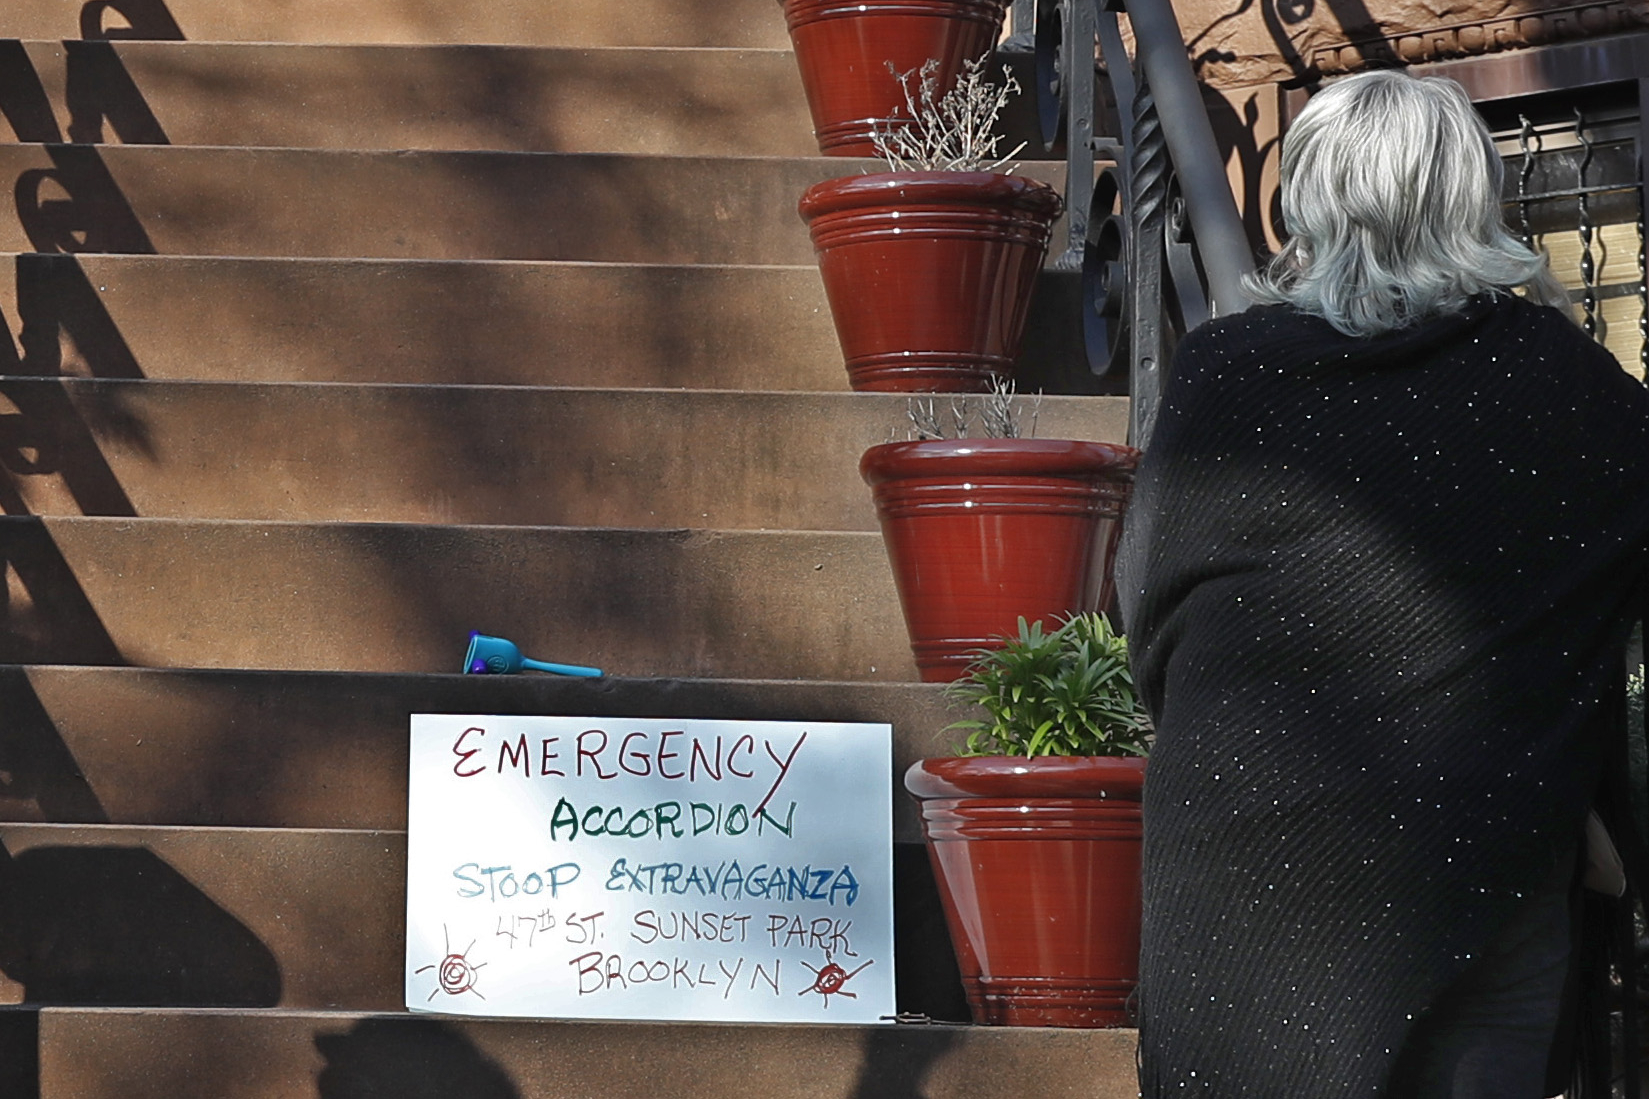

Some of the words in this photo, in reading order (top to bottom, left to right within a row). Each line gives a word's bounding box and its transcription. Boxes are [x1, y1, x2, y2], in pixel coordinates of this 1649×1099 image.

[452, 727, 808, 819] EMERGENCY
[550, 797, 798, 842] ACCORDION
[452, 861, 581, 902] STOOP
[605, 858, 860, 906] EXTRAVAGANZA
[564, 912, 605, 947] ST.
[630, 910, 752, 947] SUNSET
[767, 914, 858, 957] PARK
[568, 951, 781, 997] BROOKLYN
